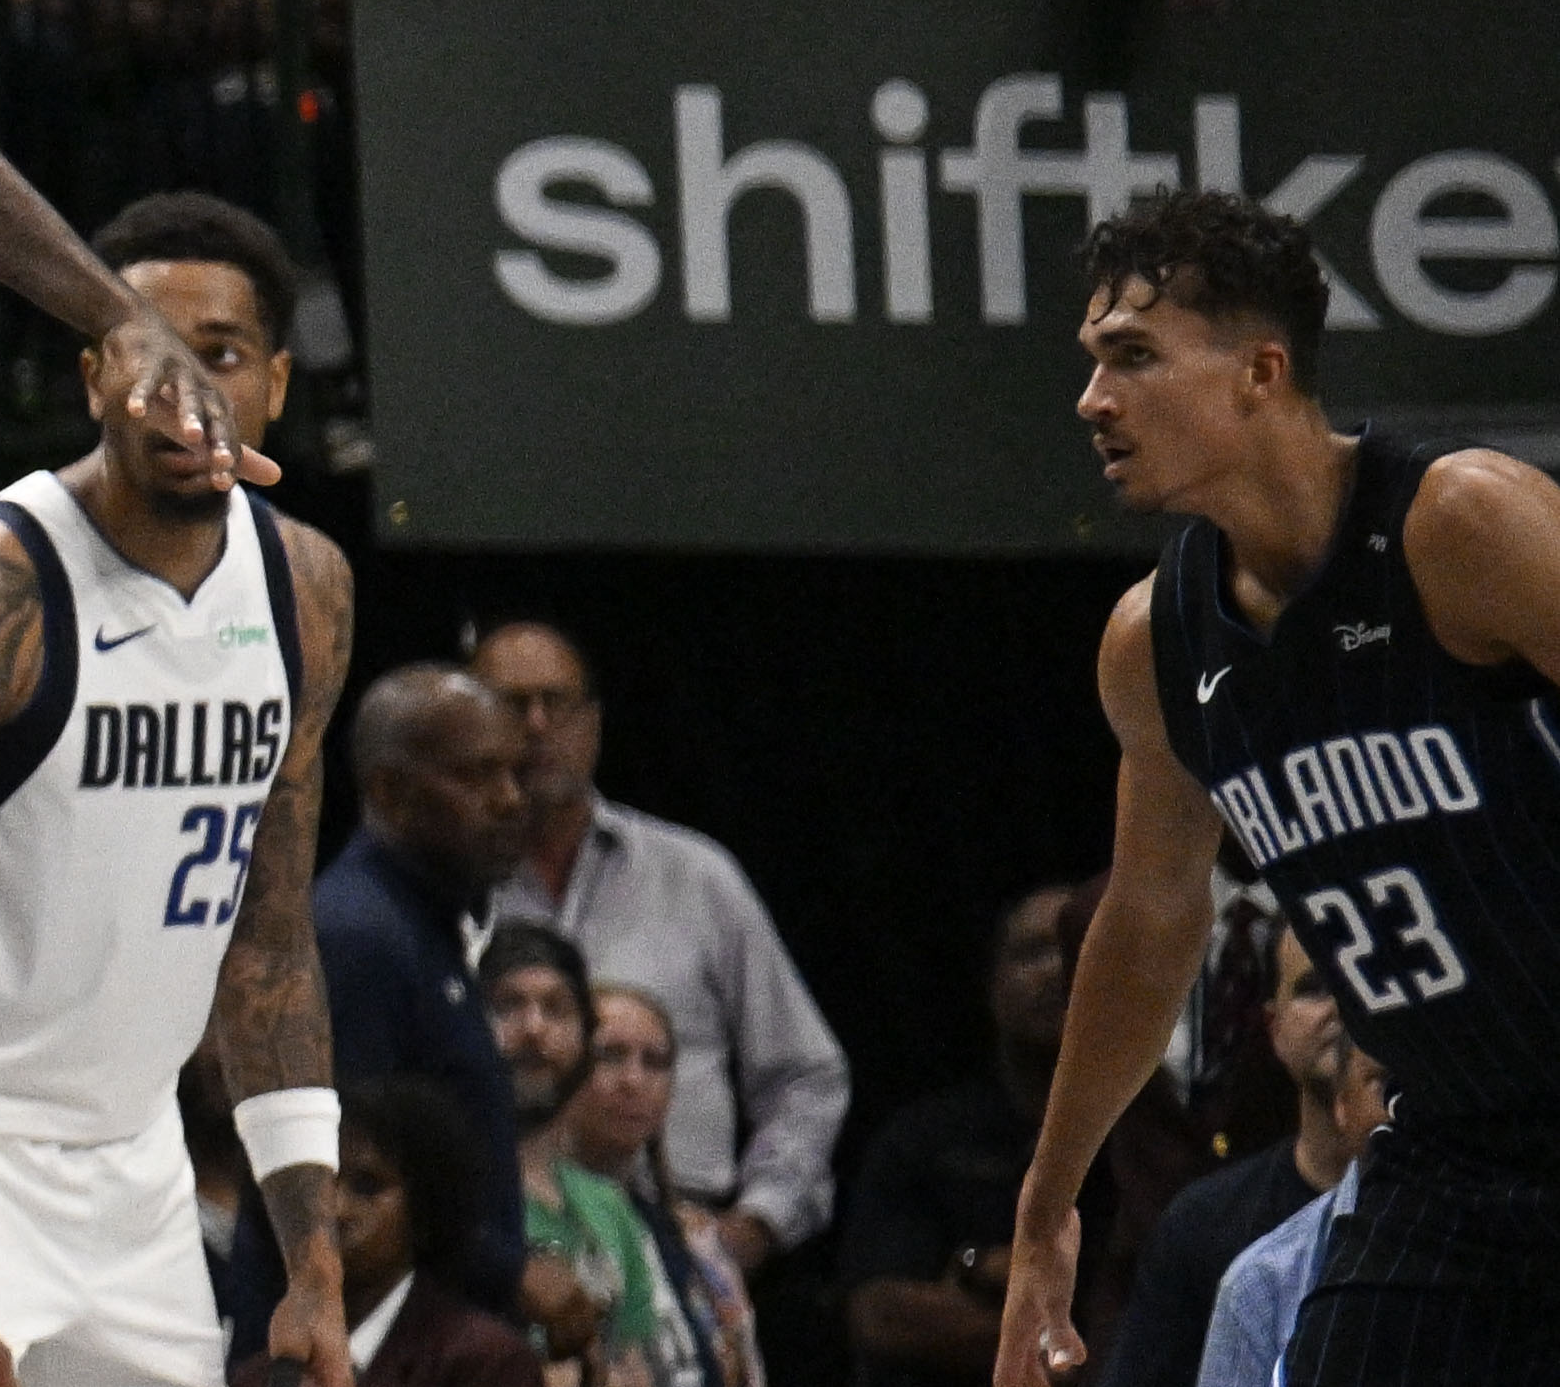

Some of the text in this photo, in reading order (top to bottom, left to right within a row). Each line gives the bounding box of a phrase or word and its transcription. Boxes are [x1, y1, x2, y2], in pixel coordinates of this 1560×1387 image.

[493, 72, 1560, 336] shiftke
[1332, 619, 1392, 652] Disney
[79, 699, 283, 789] DALLAS
[1303, 865, 1470, 1016] 23
